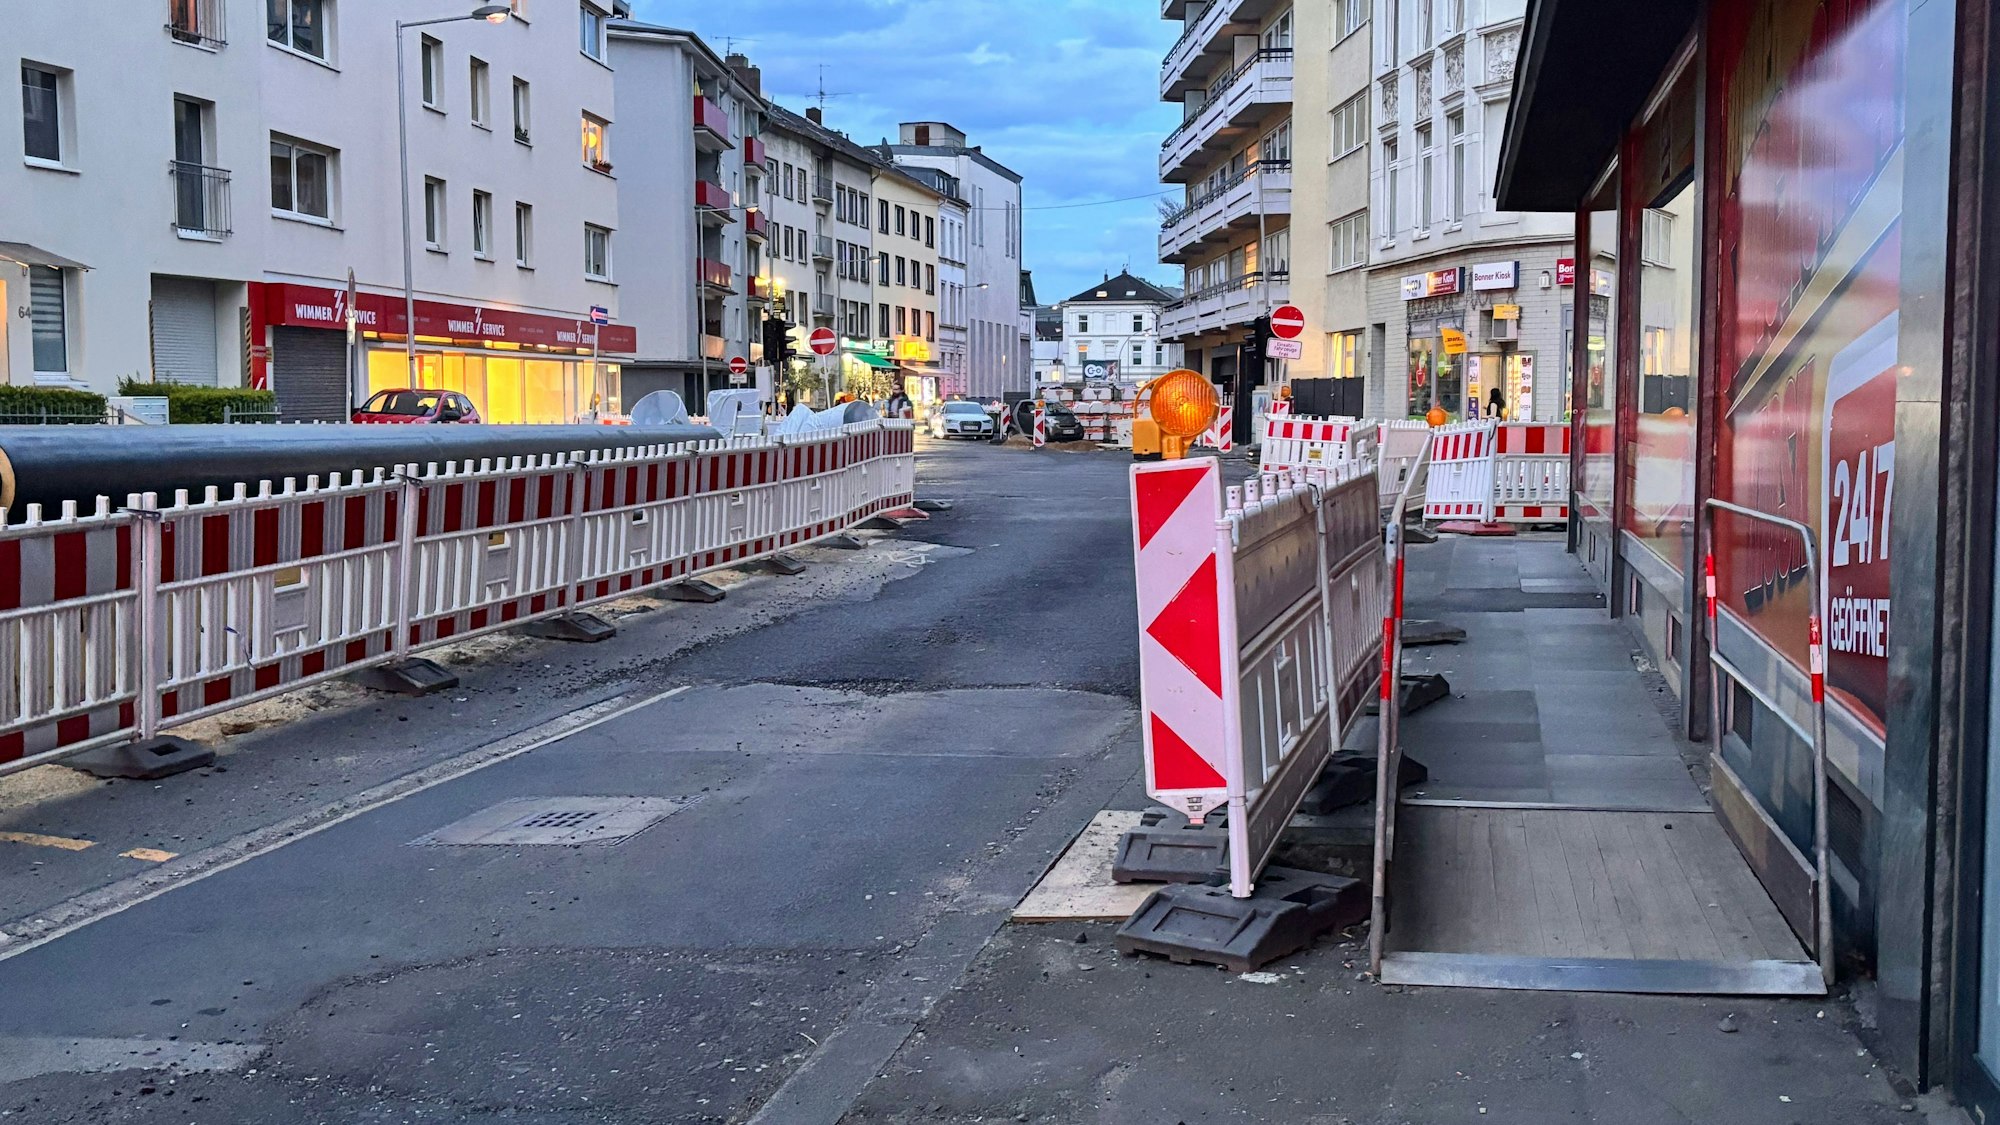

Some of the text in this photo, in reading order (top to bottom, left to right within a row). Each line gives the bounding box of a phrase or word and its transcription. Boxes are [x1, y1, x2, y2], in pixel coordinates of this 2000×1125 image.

[1474, 270, 1511, 281] Bonner Kiosk
[1558, 264, 1575, 274] Bon
[18, 306, 31, 318] 64
[295, 303, 333, 322] WIMMER
[344, 308, 376, 325] SRVICE
[448, 319, 474, 334] WIMMER
[482, 323, 505, 337] SERVICE
[556, 330, 577, 343] WIMMER
[1832, 440, 1895, 567] 24/7
